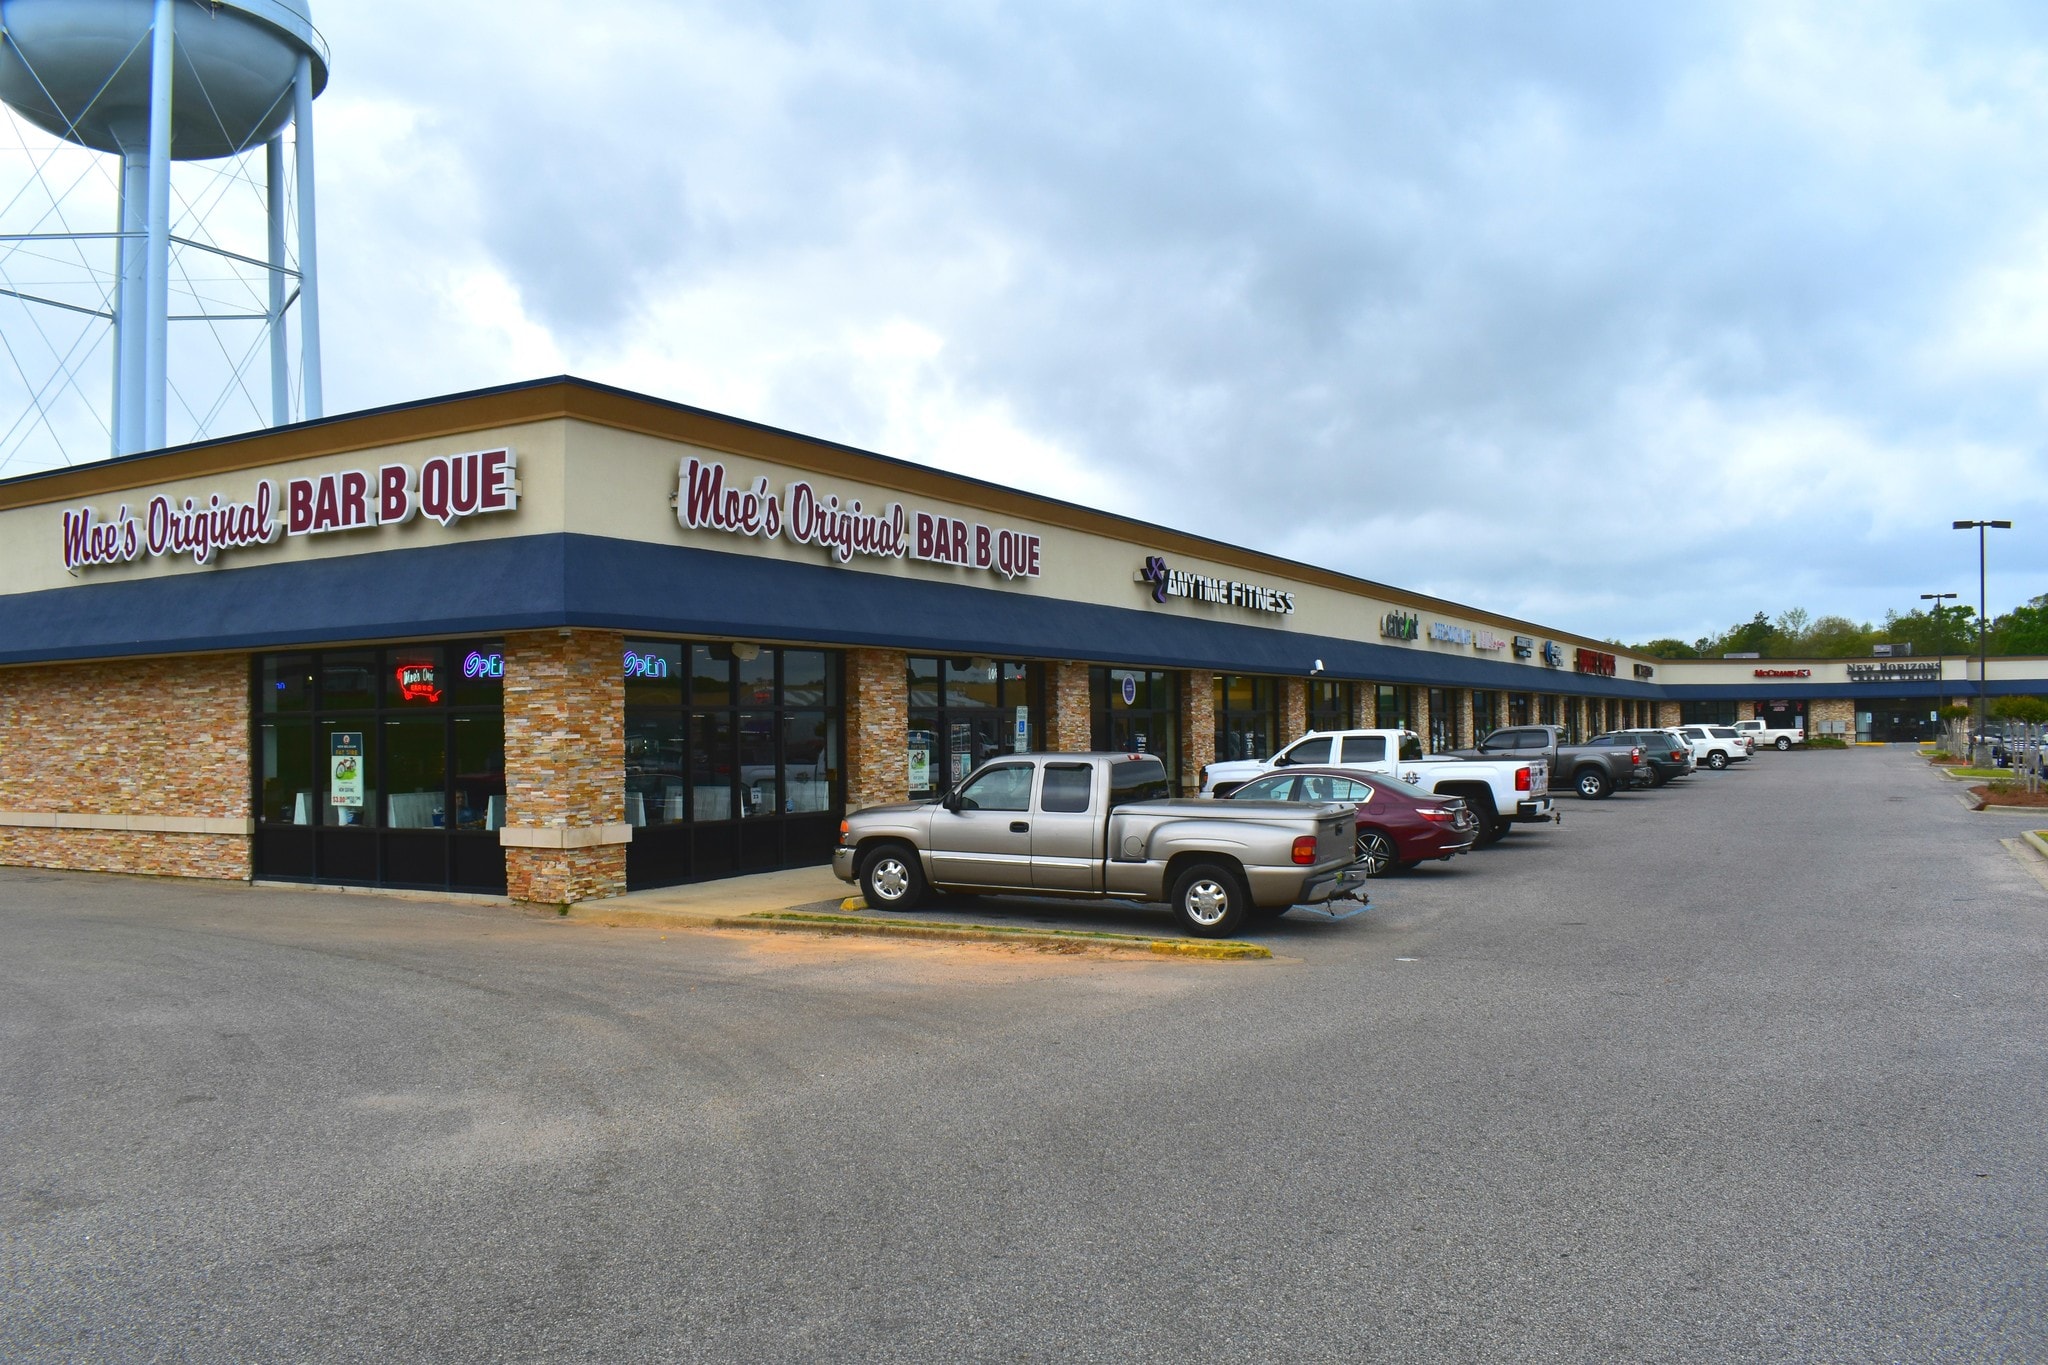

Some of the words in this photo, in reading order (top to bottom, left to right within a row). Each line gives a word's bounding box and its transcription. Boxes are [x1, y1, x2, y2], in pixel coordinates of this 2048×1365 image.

[63, 505, 138, 569] Moe's
[147, 480, 274, 565] Original
[288, 470, 368, 536] BAR
[379, 464, 410, 525] B
[421, 448, 509, 526] QUE
[686, 458, 781, 539] Moe's
[792, 481, 905, 563] Original
[916, 511, 969, 566] BAR
[976, 524, 992, 570] B
[998, 529, 1041, 580] QUE
[1167, 569, 1228, 604] ANYTIME
[1231, 582, 1295, 615] FITNESS
[1847, 663, 1875, 672] NEW
[1880, 662, 1940, 671] HORIZONS
